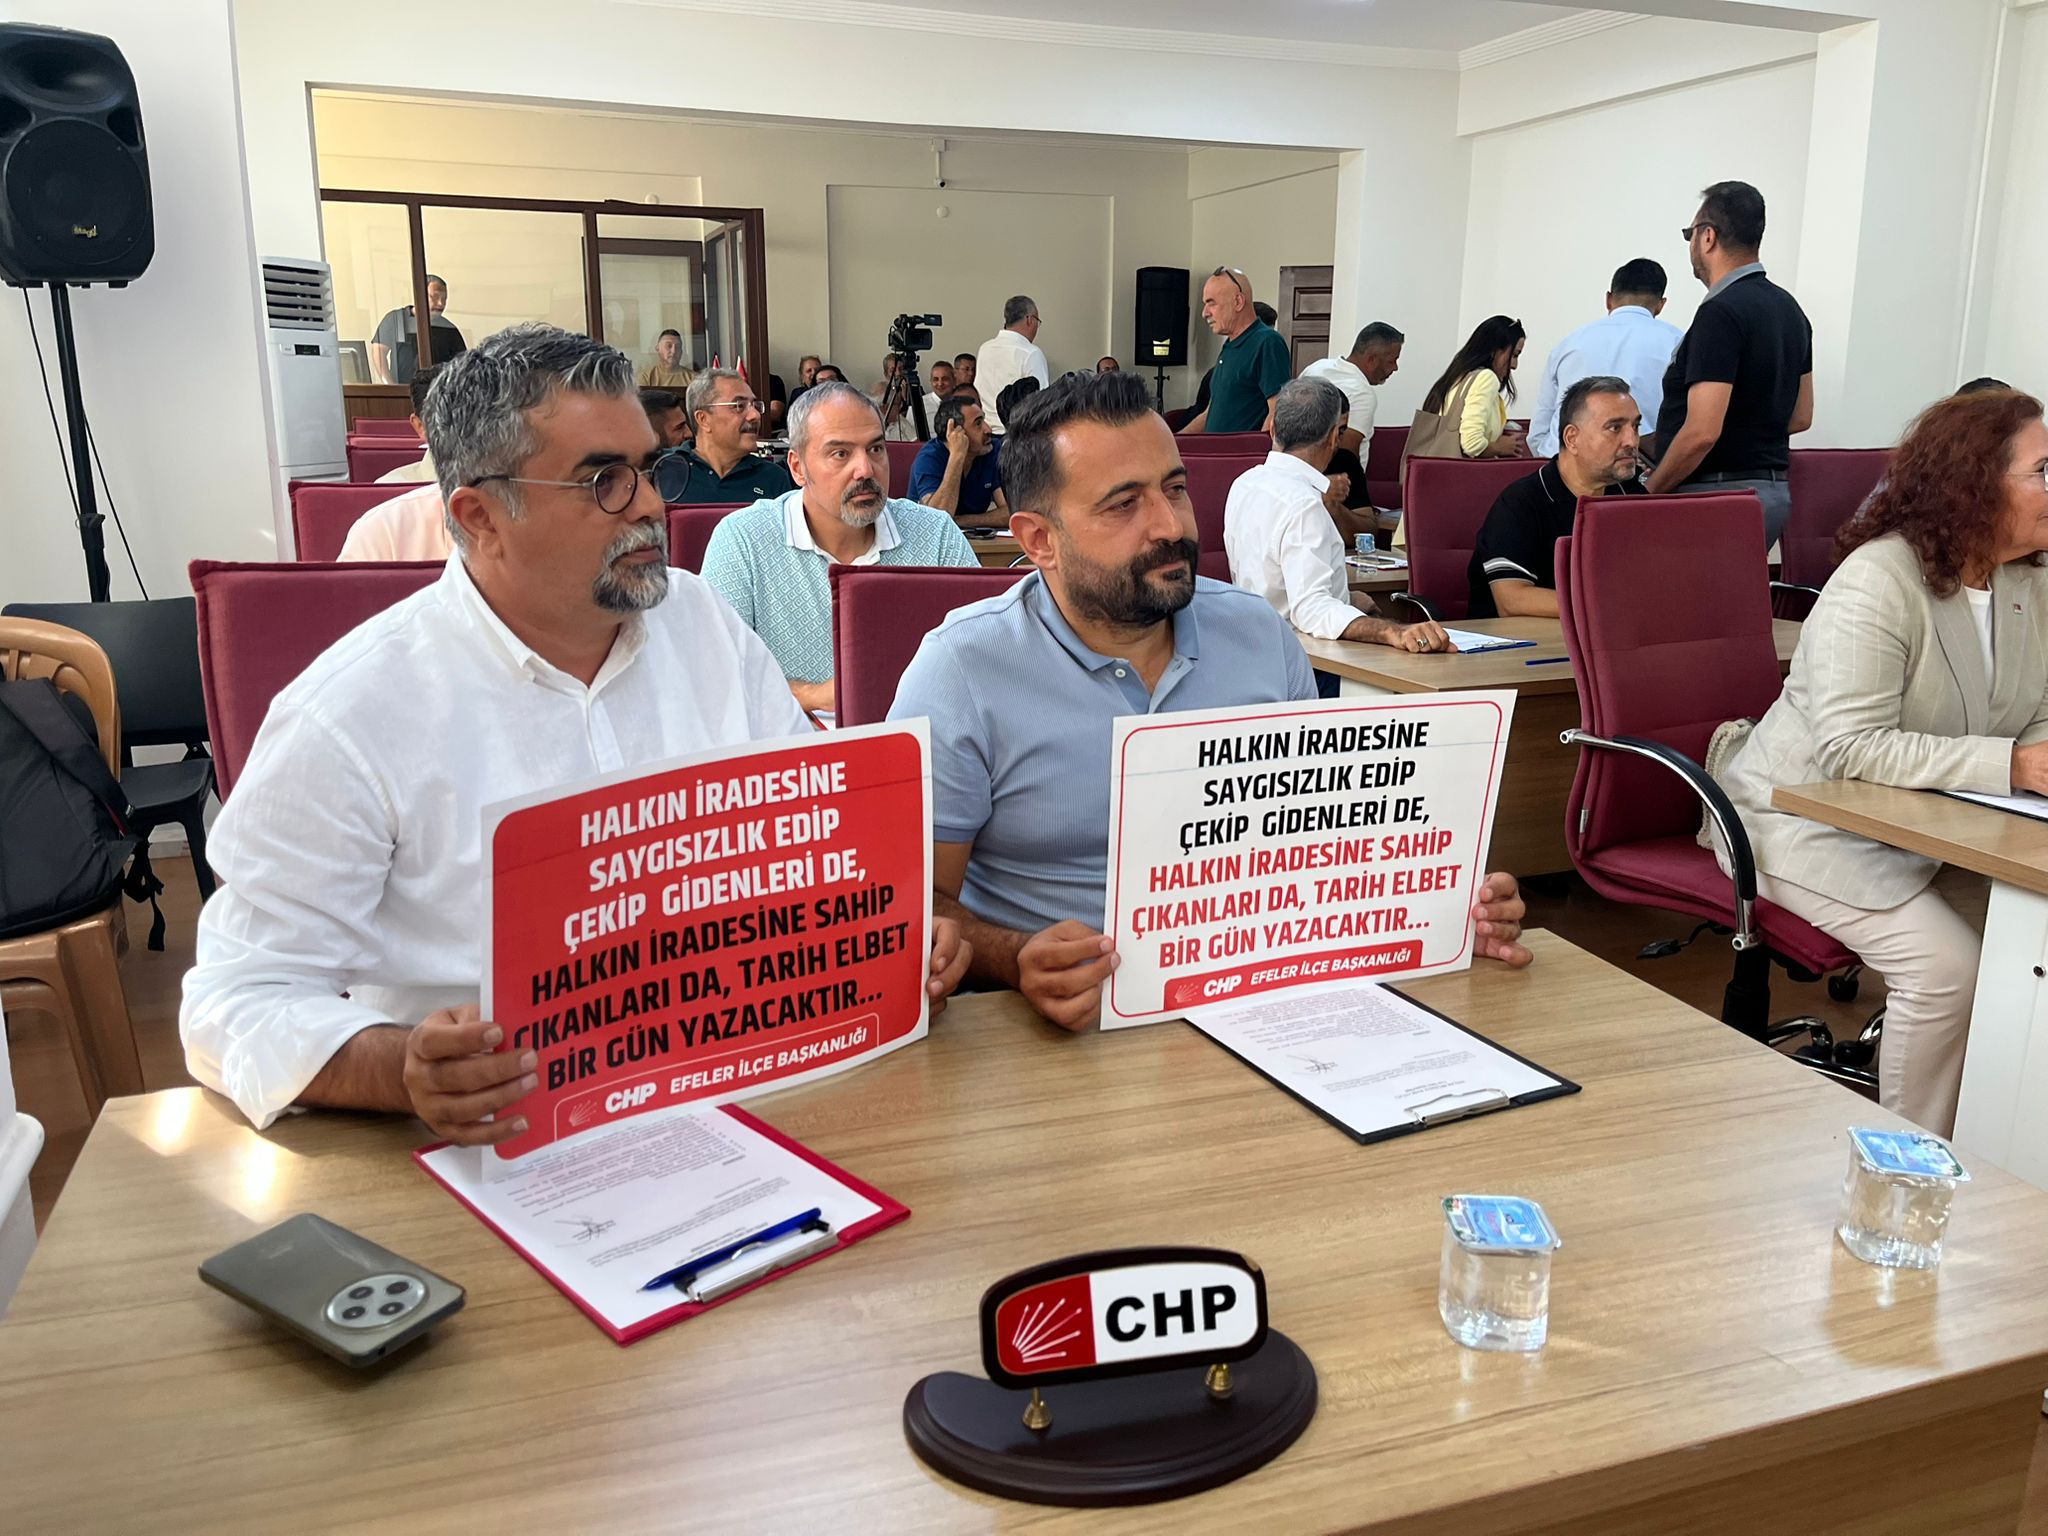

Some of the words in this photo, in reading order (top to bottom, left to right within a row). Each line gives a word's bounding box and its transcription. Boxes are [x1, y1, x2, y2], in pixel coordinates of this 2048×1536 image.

[1198, 732, 1290, 768] HALKIN
[1299, 719, 1430, 756] İRADESİNE
[580, 788, 687, 848] HALKIN
[695, 761, 847, 817] İRADESİNE
[1203, 775, 1352, 807] SAYGISIZLIK
[1359, 756, 1416, 789] EDİP
[589, 819, 767, 892] SAYGISIZLIK
[775, 804, 840, 848] EDİP
[1149, 855, 1241, 893] HALKIN
[1249, 836, 1373, 876] İRADESİNE
[1380, 825, 1452, 861] SAHİP
[1180, 812, 1249, 855] ÇEKİP
[1262, 795, 1386, 837] GİDENLERİ
[1393, 797, 1430, 825] DE,
[564, 892, 646, 954] ÇEKİP
[662, 850, 815, 916] GİDENLERİ
[823, 848, 866, 884] DE,
[1131, 889, 1260, 939] ÇIKANLARI
[1267, 884, 1306, 912] DA,
[1313, 871, 1385, 904] TARİH
[1392, 864, 1462, 895] ELBET
[1159, 936, 1200, 969] BİR
[1208, 922, 1256, 960] GÜN
[1263, 906, 1430, 949] YAZACAKTIR...
[532, 940, 640, 1006] HALKIN
[650, 903, 807, 966] İRADESİNE
[815, 882, 894, 929] SAHİP
[680, 966, 731, 1003] DA,
[738, 942, 826, 989] TARİH
[835, 922, 909, 969] ELBET
[1203, 974, 1242, 997] CHP
[1250, 966, 1299, 986] EFELER
[1299, 958, 1329, 978] İLÇE
[1331, 947, 1411, 973] BAŞKANLIĞI
[548, 1047, 597, 1091] BİR
[606, 1024, 669, 1068] GÜN
[678, 979, 882, 1048] YAZACAKTIR...
[605, 1082, 657, 1113] CHP
[670, 1066, 734, 1094] EFELER
[738, 1055, 774, 1078] İLÇE
[777, 1027, 868, 1067] BAŞKANLIĞI
[1105, 1284, 1237, 1342] CHP
